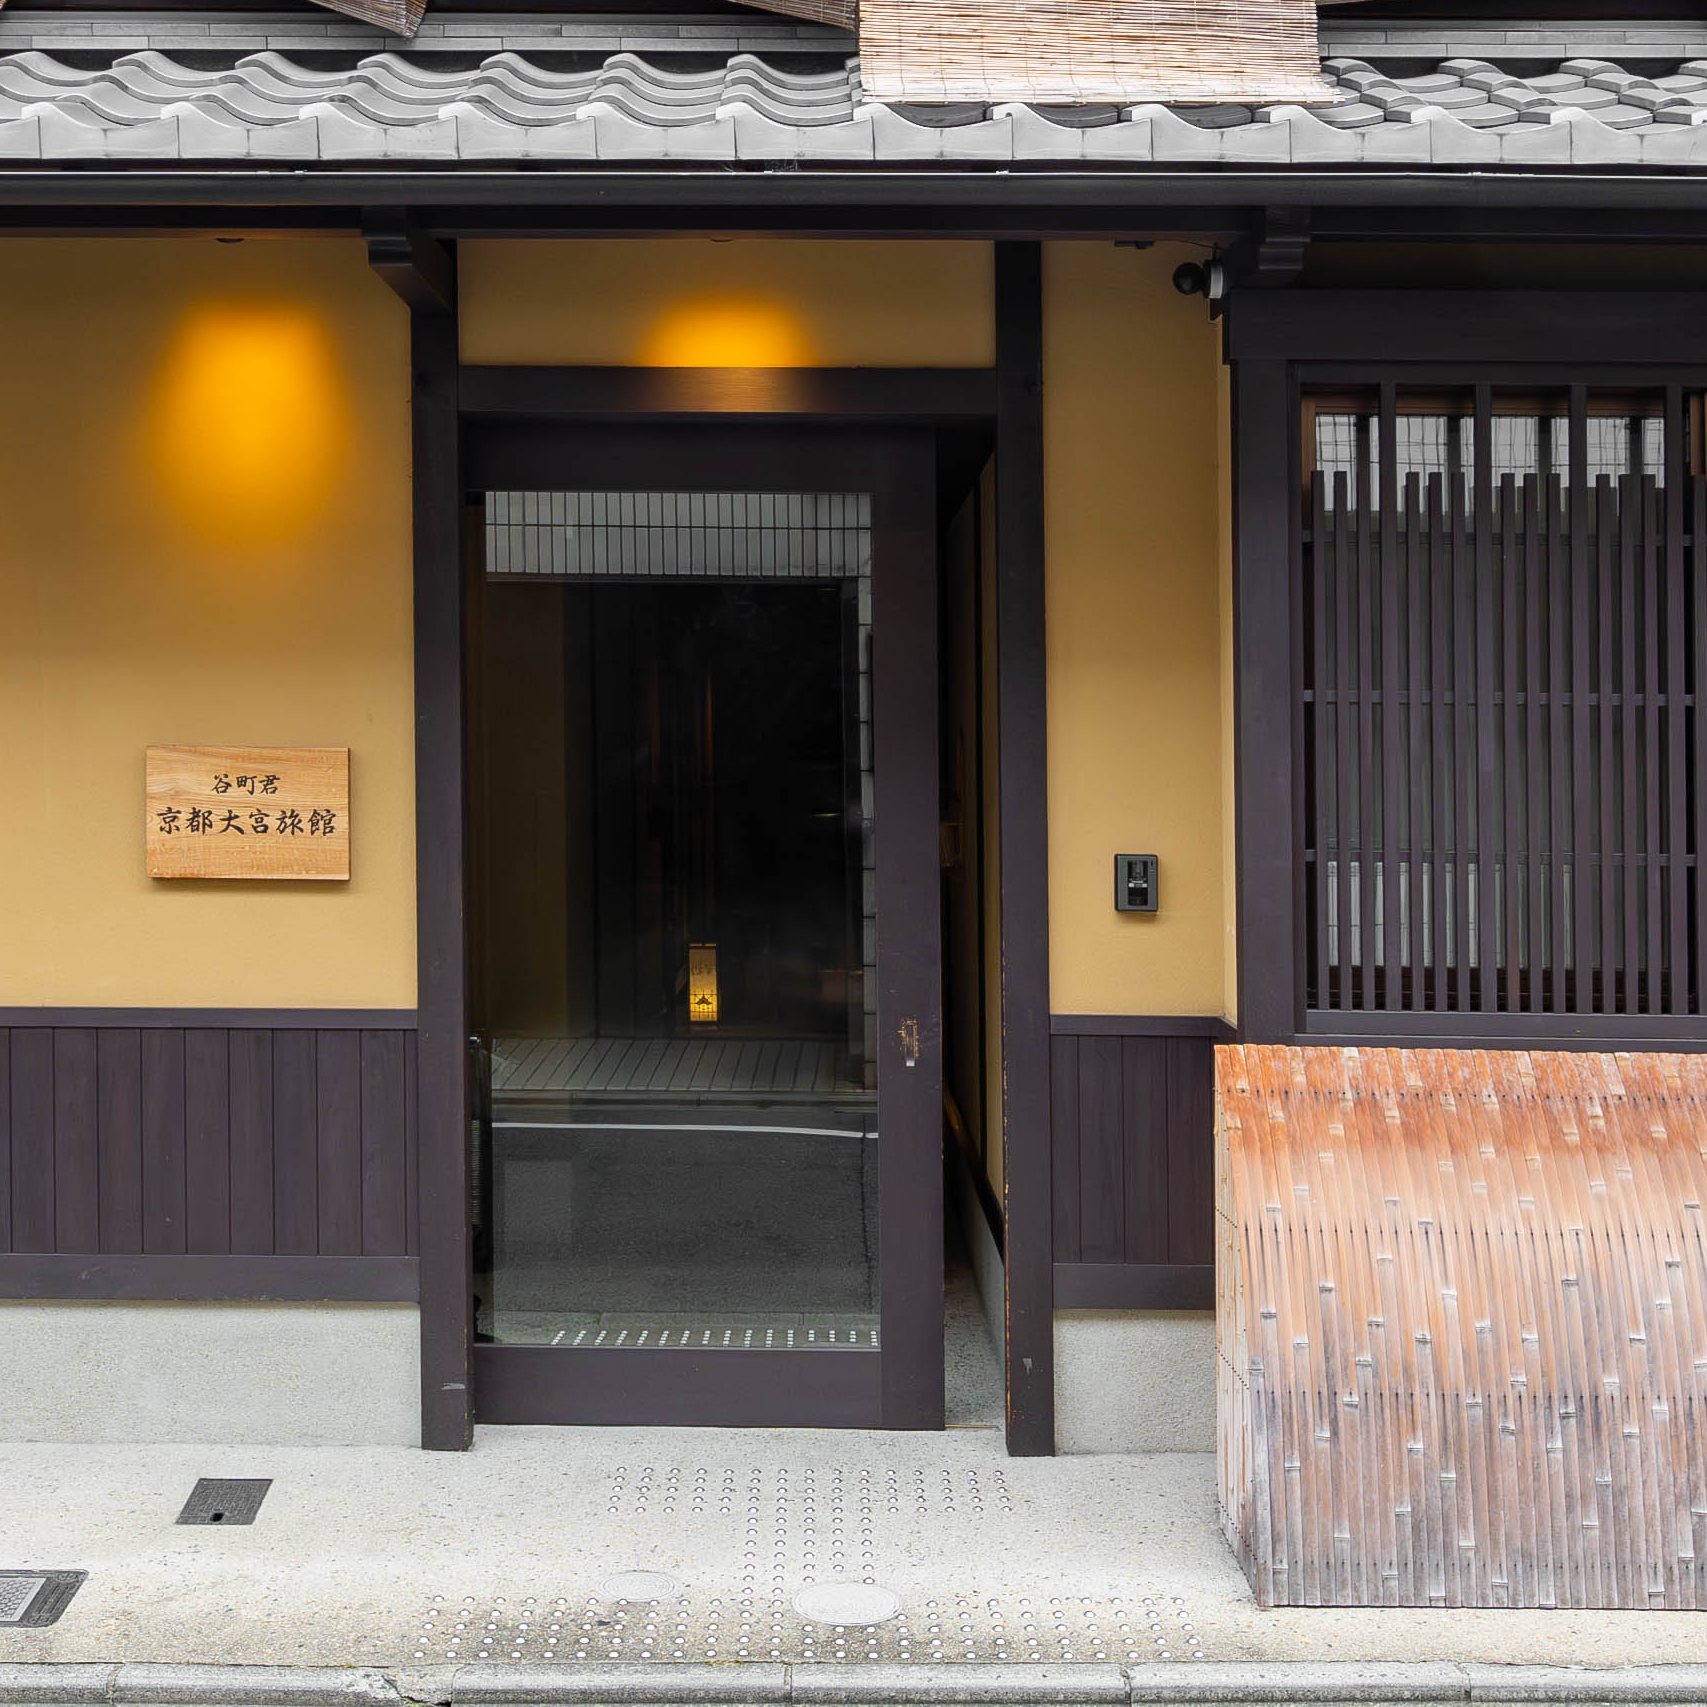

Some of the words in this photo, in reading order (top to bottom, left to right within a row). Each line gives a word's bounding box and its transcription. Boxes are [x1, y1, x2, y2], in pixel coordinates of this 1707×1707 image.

[211, 773, 281, 796] 谷町君
[156, 806, 337, 837] 京都大宮旅館
